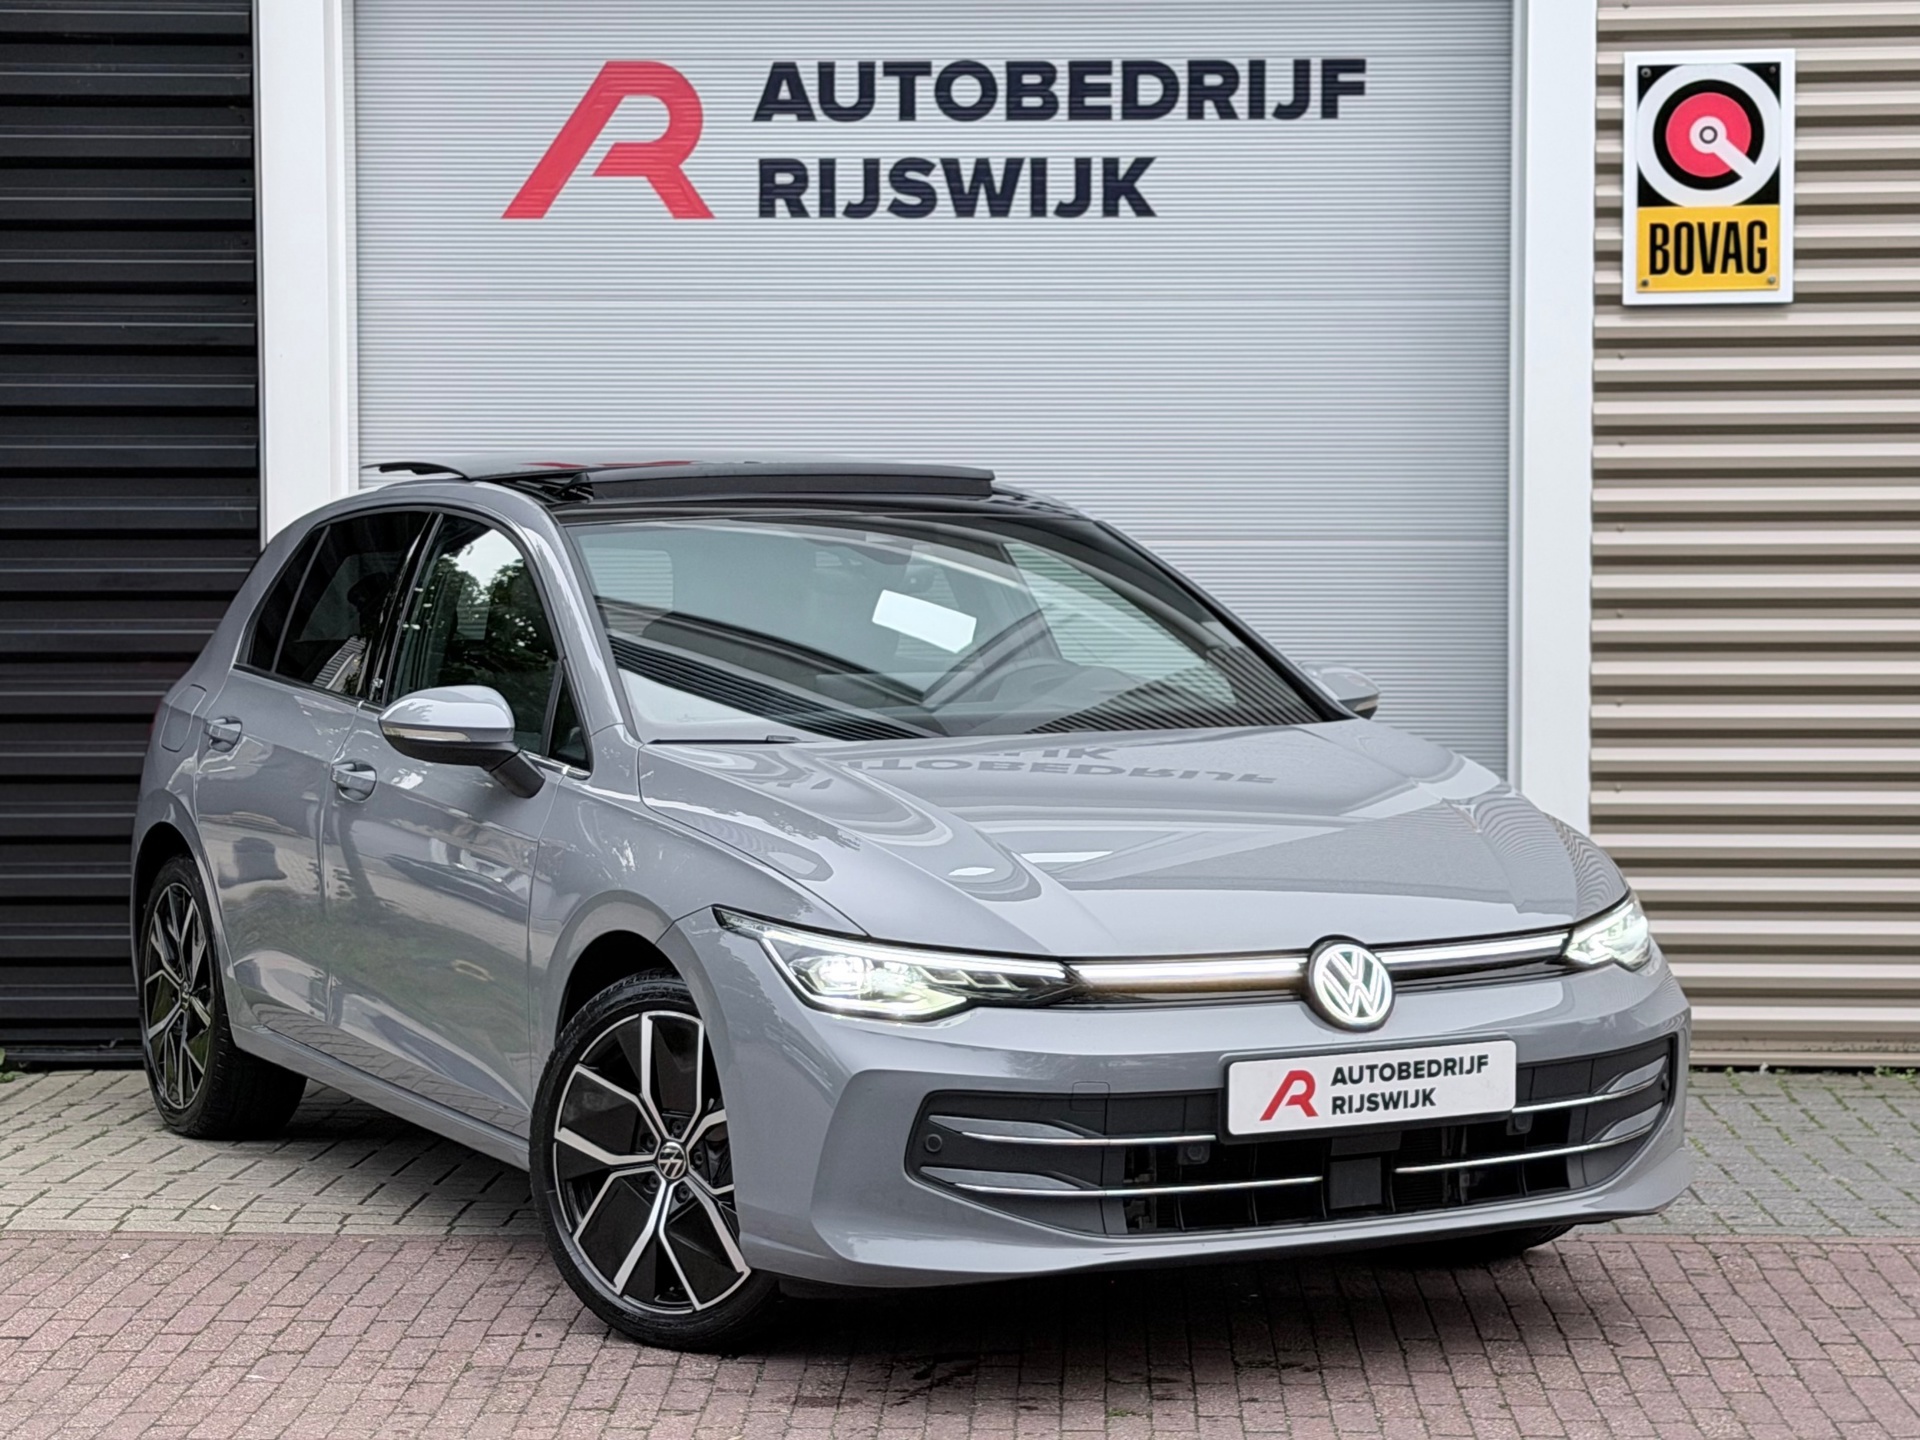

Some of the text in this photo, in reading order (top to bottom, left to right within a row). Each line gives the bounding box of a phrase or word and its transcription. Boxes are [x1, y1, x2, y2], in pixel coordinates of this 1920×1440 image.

[753, 58, 1367, 123] AUTOBEDRIJF
[758, 155, 1157, 220] RIJSWIJK
[1649, 219, 1768, 276] BOVAG
[1330, 1054, 1489, 1087] AUTOBEDRIJF
[1331, 1087, 1437, 1115] RIJSWIJK
